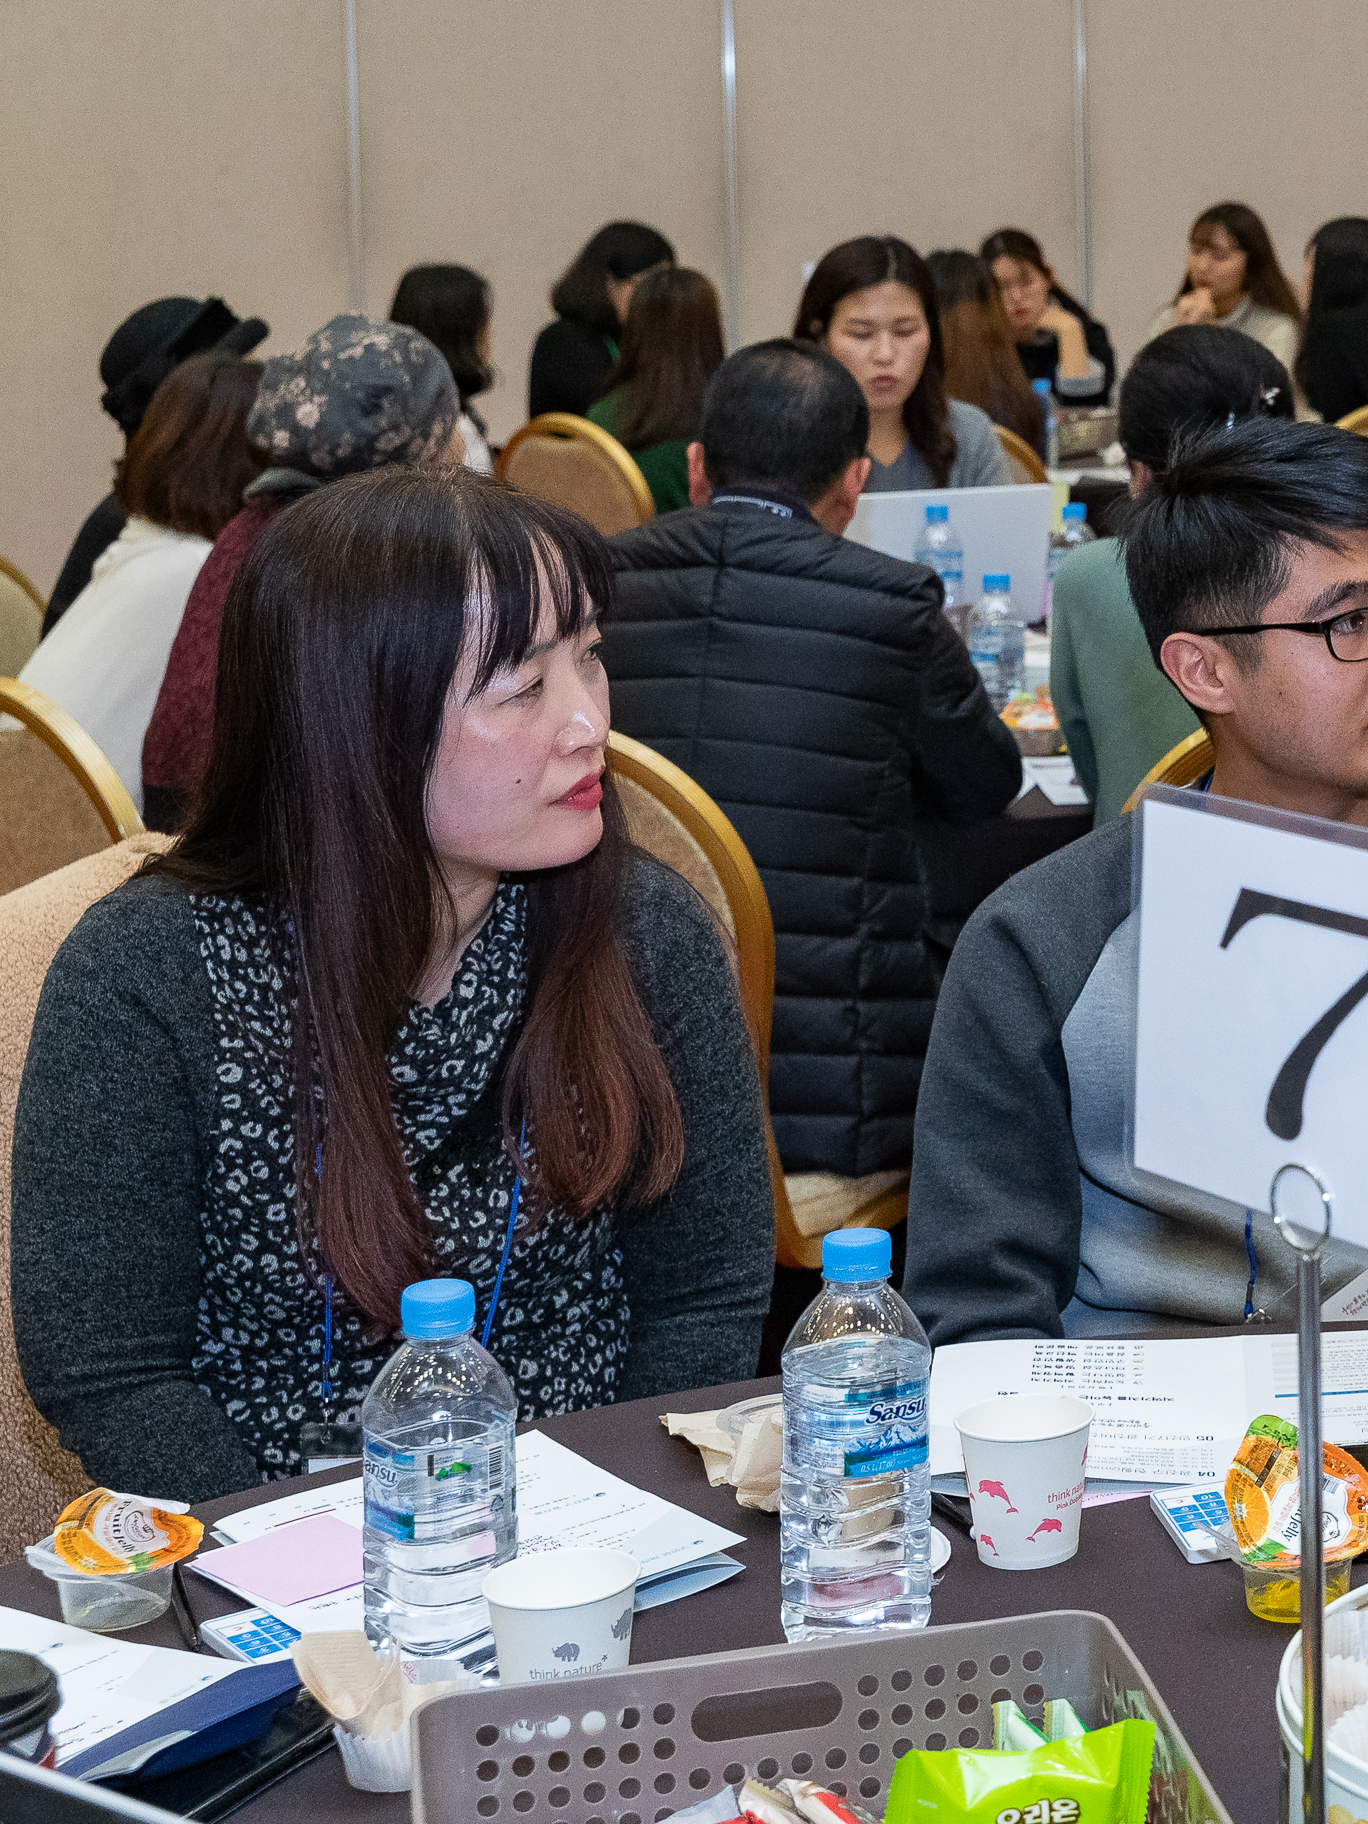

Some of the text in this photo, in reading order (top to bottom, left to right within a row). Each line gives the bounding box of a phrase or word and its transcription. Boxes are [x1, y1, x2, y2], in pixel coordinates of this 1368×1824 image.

[866, 1397, 927, 1424] Sansu
[365, 1458, 398, 1484] ansu
[1047, 1488, 1070, 1503] think
[529, 1668, 560, 1680] think
